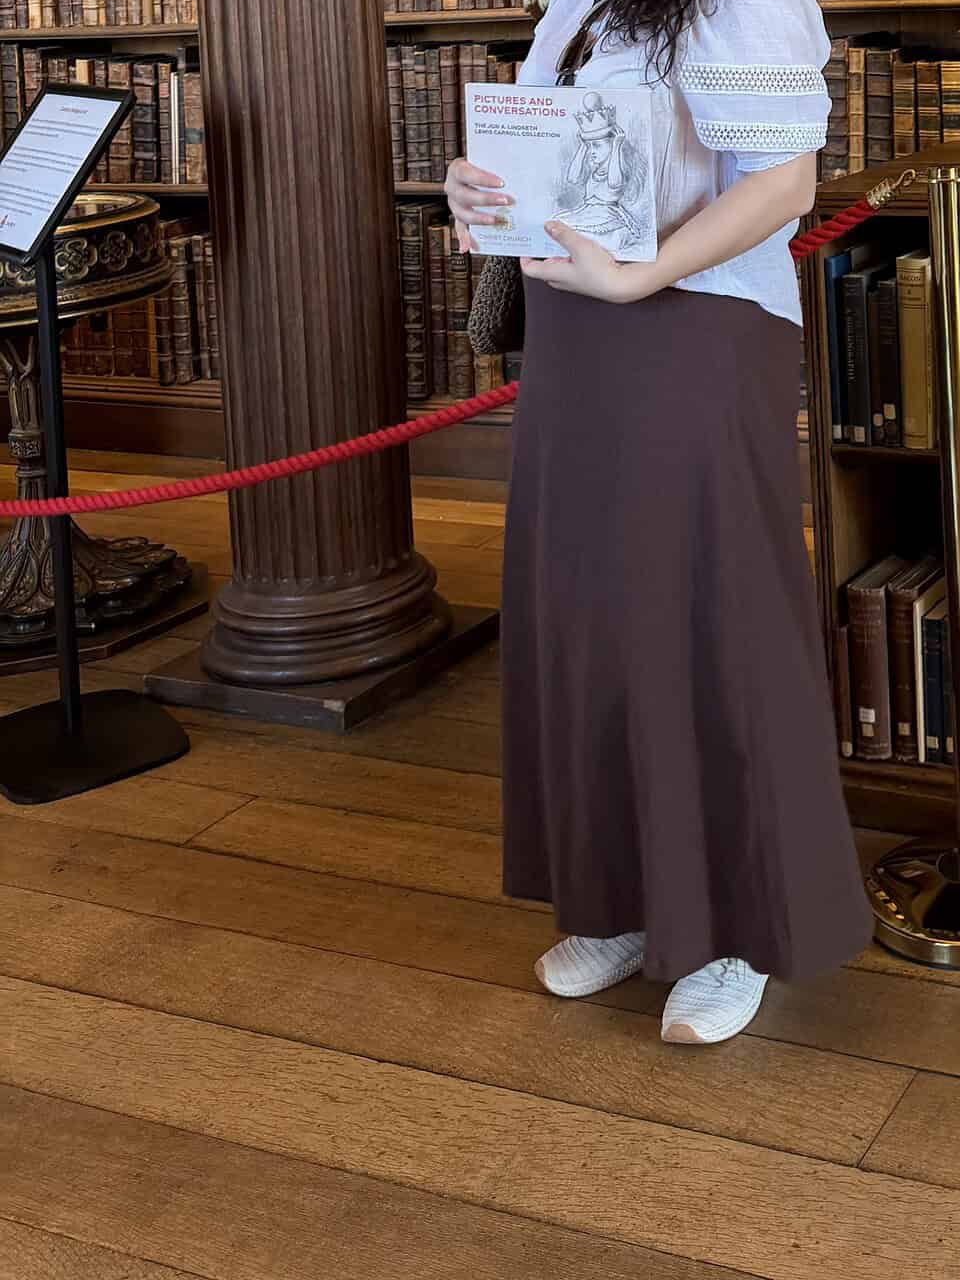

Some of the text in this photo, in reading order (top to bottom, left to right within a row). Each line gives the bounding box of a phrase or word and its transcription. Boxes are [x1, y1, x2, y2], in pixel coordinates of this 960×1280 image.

[474, 95, 553, 106] PICTURES AND
[474, 105, 567, 117] CONVERSATIONS
